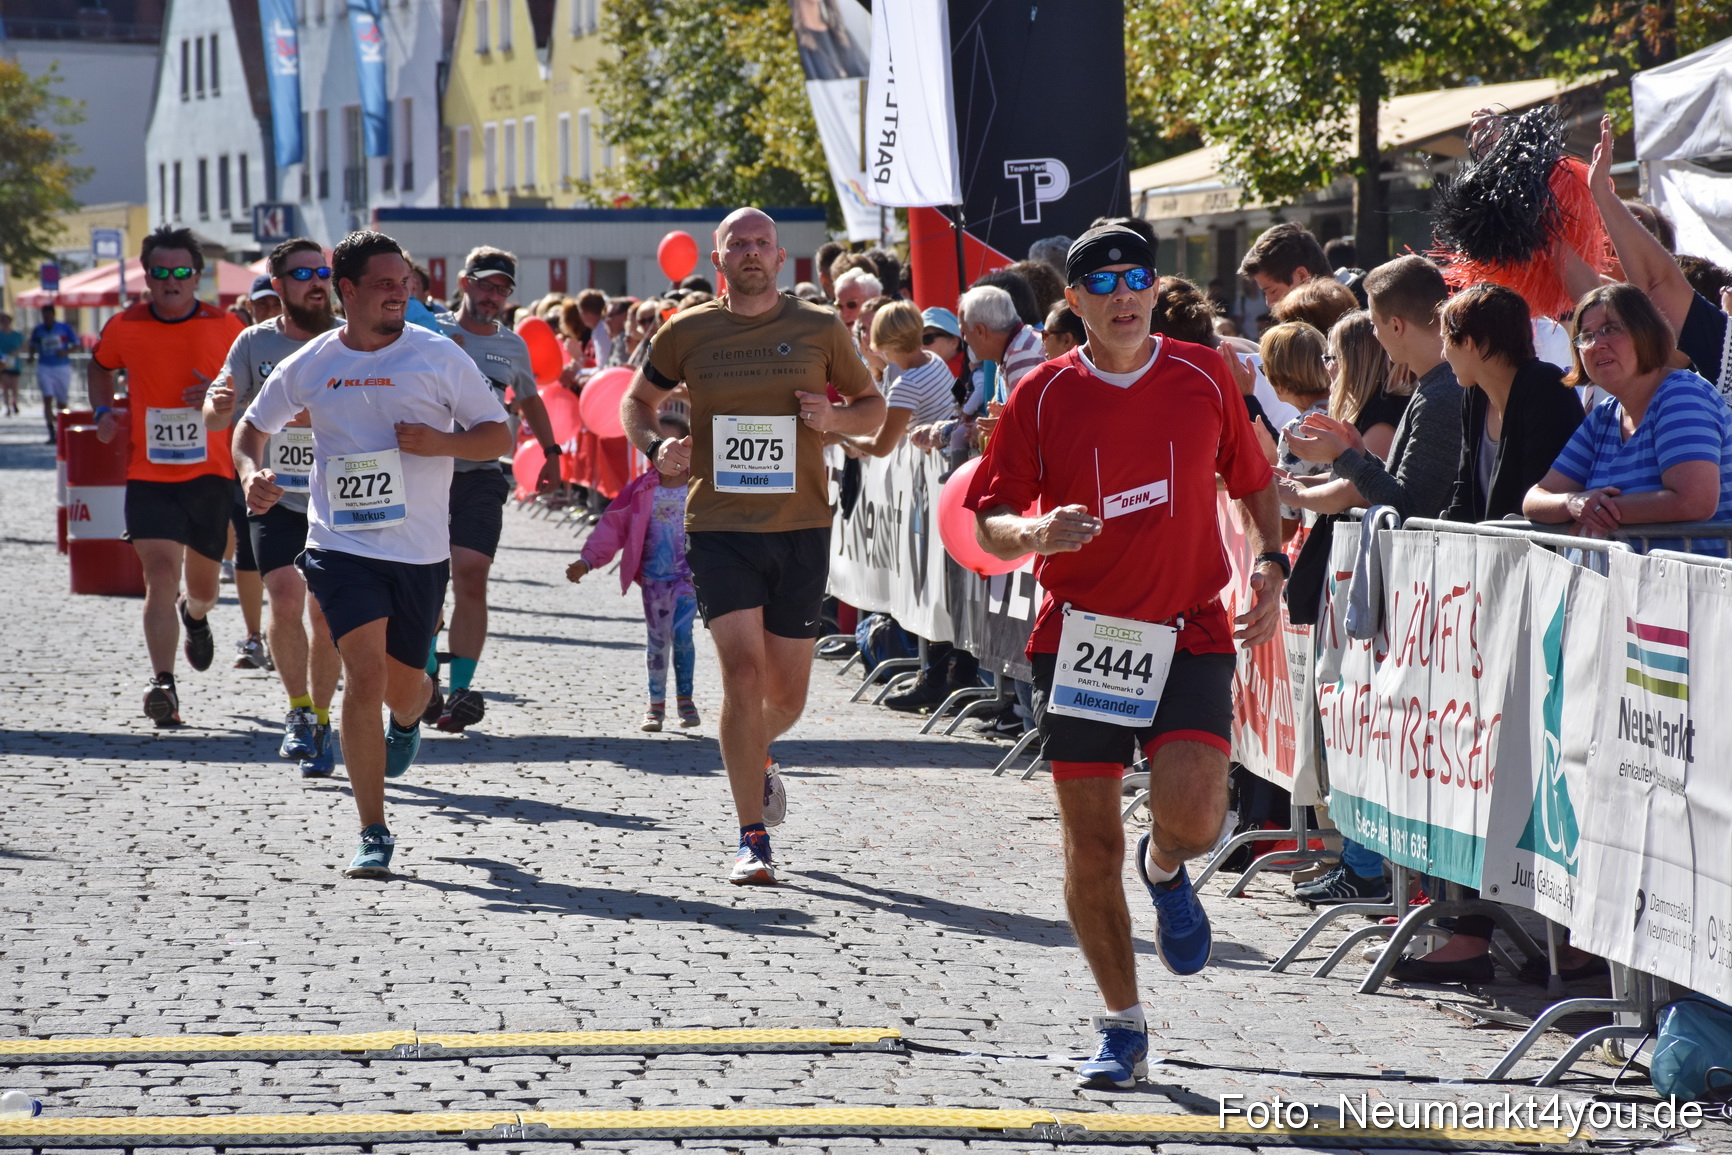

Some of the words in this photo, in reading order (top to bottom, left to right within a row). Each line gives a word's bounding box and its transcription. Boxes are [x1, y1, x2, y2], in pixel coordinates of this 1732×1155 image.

[712, 347, 774, 360] elements
[772, 367, 808, 376] ENERGIE
[344, 378, 396, 387] KLEBL
[154, 423, 198, 441] 2112
[736, 423, 773, 433] BOCK
[725, 437, 784, 461] 2075
[345, 459, 378, 471] BOCK
[337, 472, 393, 499] 2272
[739, 475, 769, 485] André
[1121, 491, 1150, 508] DEHN
[352, 511, 386, 522] Markus
[1094, 624, 1143, 643] BOCK
[1073, 642, 1153, 684] 2444
[1077, 678, 1100, 688] PARTL
[1102, 682, 1134, 694] Neumarkt
[1073, 691, 1140, 715] Alexander
